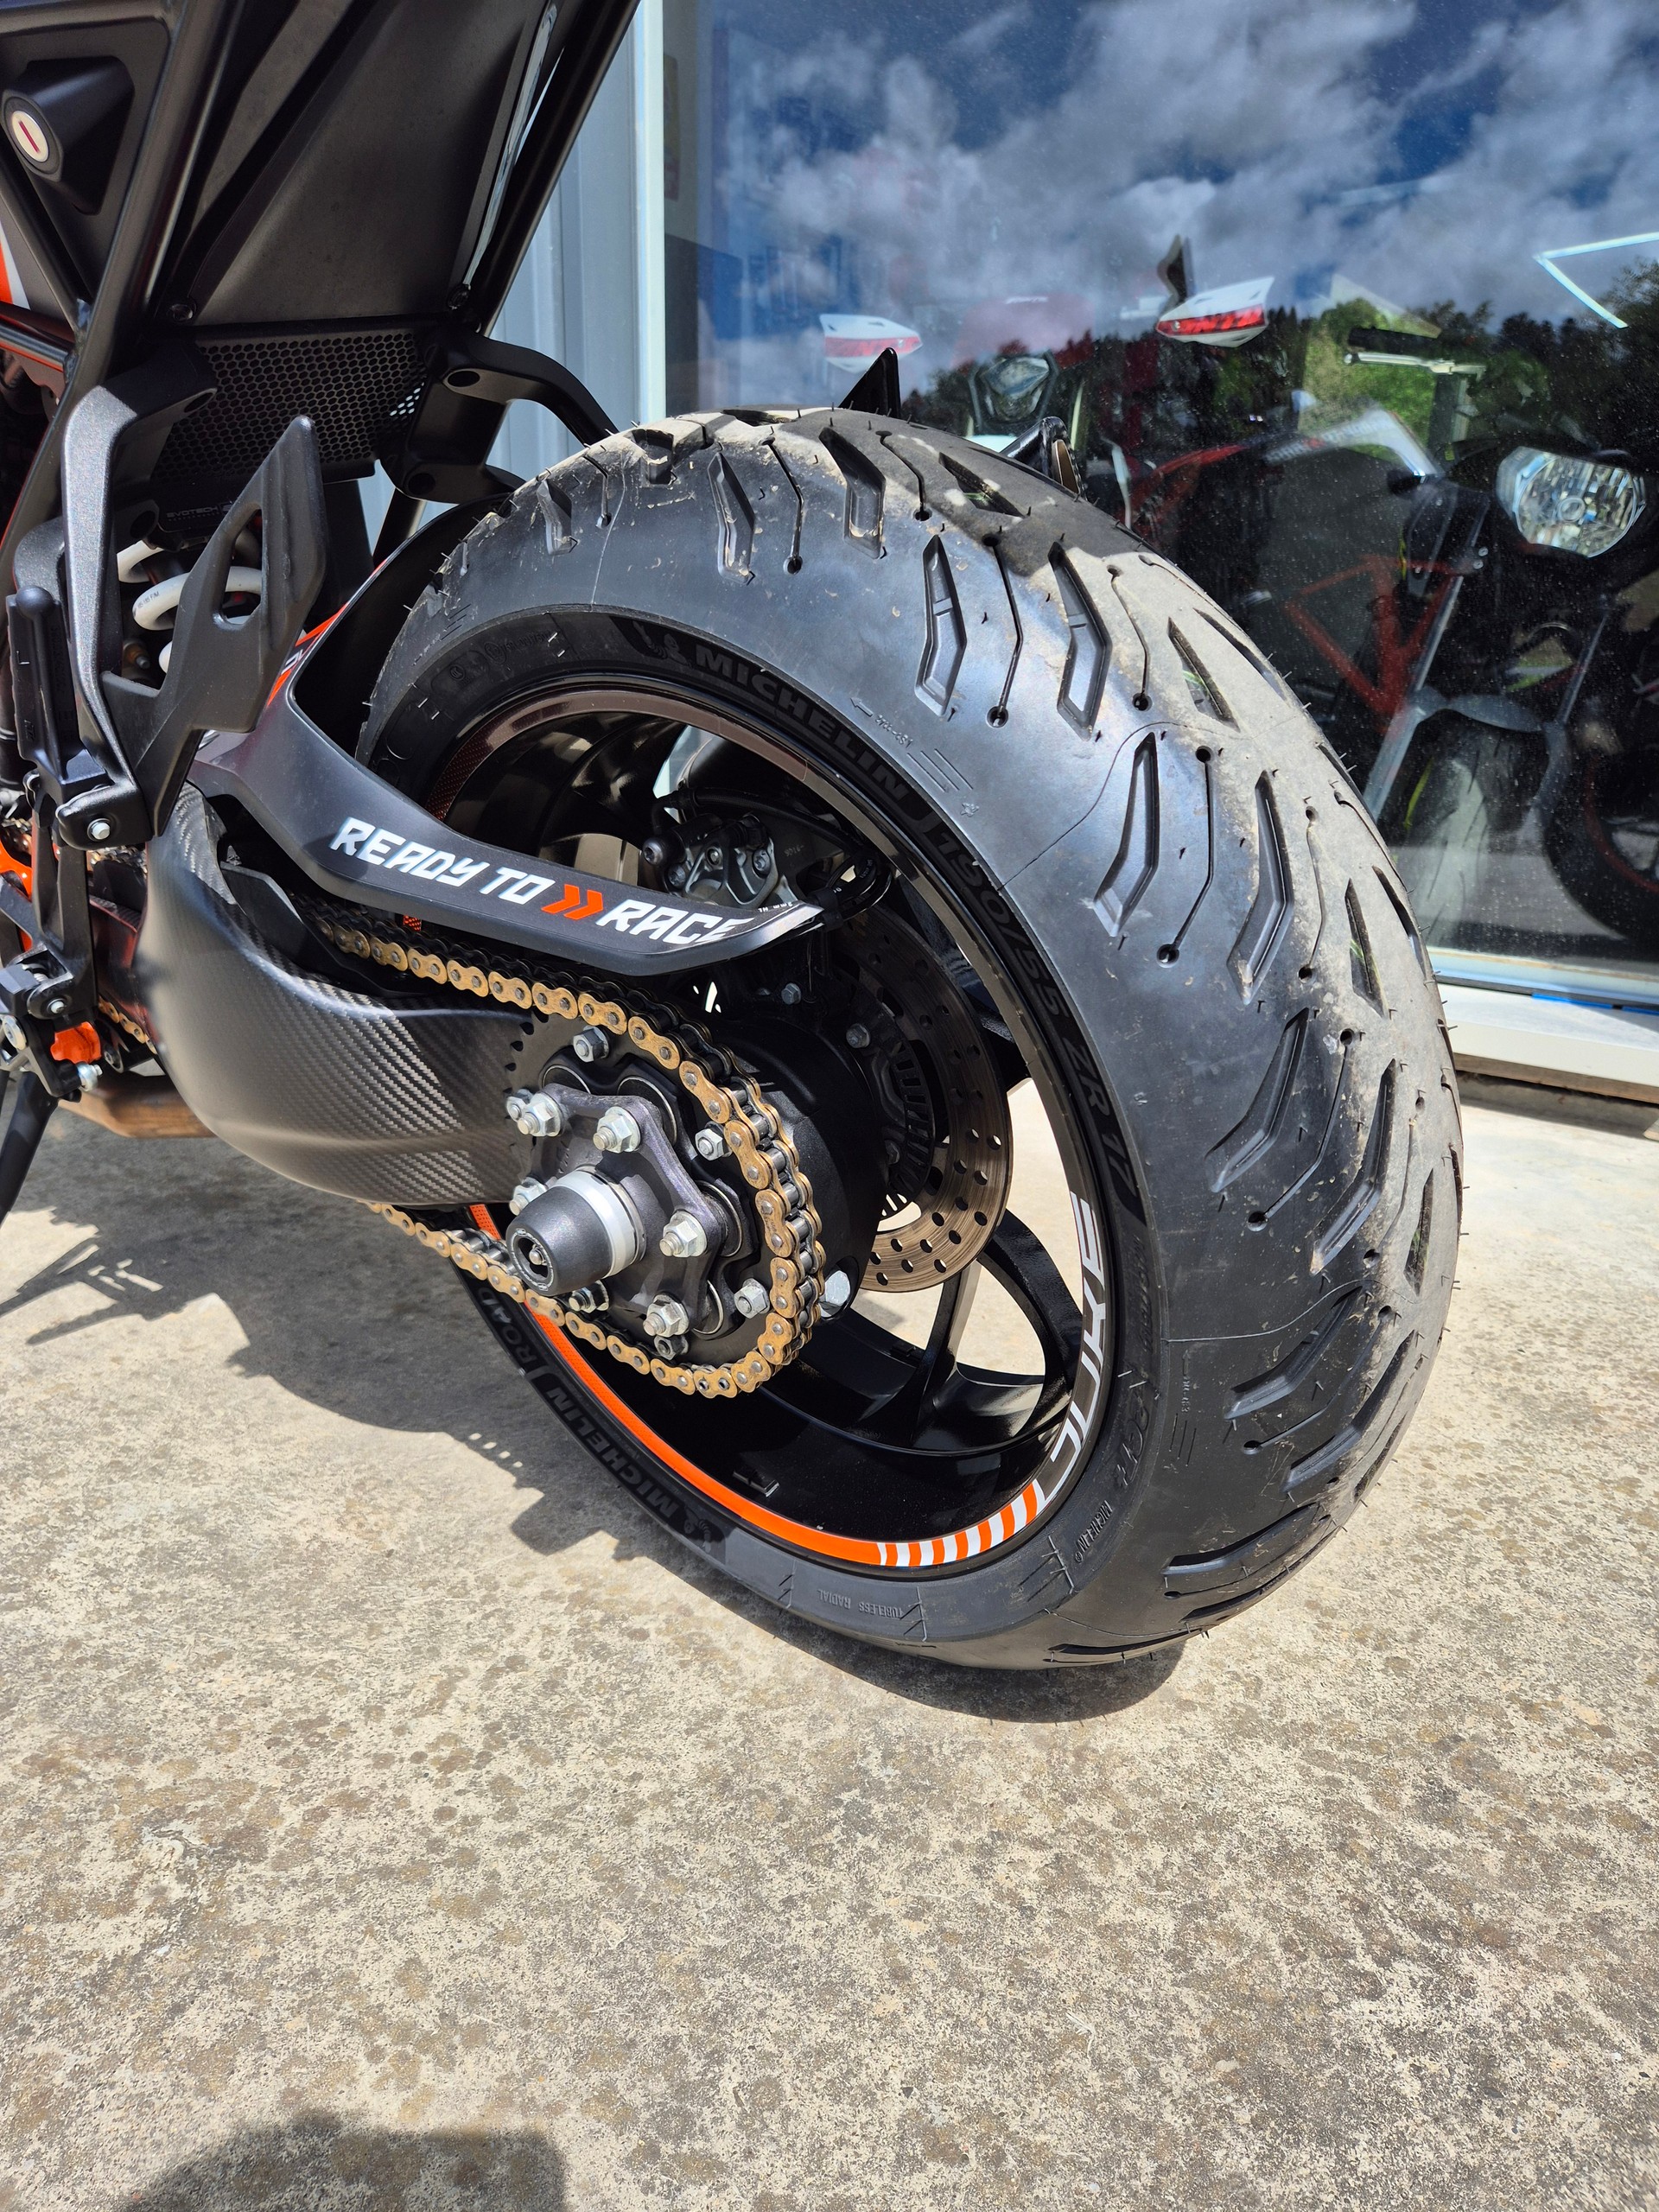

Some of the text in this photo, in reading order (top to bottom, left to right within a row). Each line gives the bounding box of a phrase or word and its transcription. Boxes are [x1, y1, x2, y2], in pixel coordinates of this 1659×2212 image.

[695, 645, 909, 801] MICHELIN
[328, 817, 754, 944] READY TO RACE
[480, 1287, 536, 1364] ROAD
[1033, 1191, 1106, 1503] DUKE
[546, 1387, 680, 1520] MICHELIN
[817, 1588, 904, 1619] TUBELESS RADIAL
